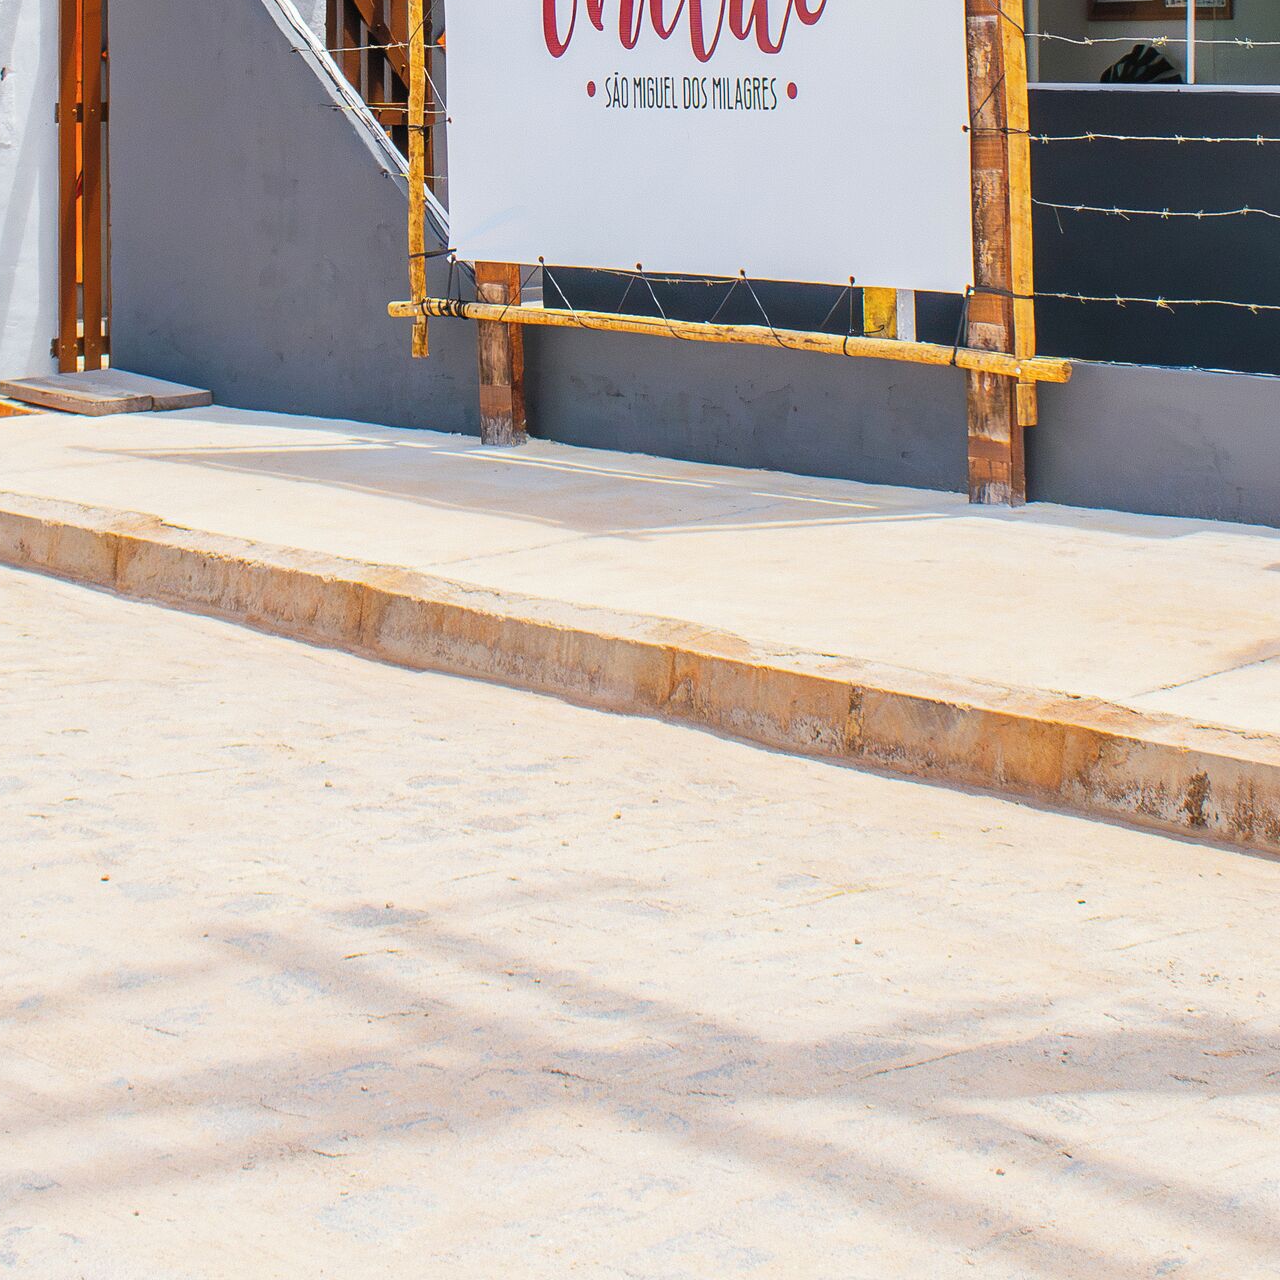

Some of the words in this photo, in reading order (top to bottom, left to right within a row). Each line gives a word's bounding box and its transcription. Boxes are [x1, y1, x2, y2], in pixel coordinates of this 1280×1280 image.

[604, 70, 629, 109] SÃO
[632, 76, 679, 110] MIGUEL
[682, 76, 708, 110] DOS
[712, 76, 778, 111] MILAGRES
